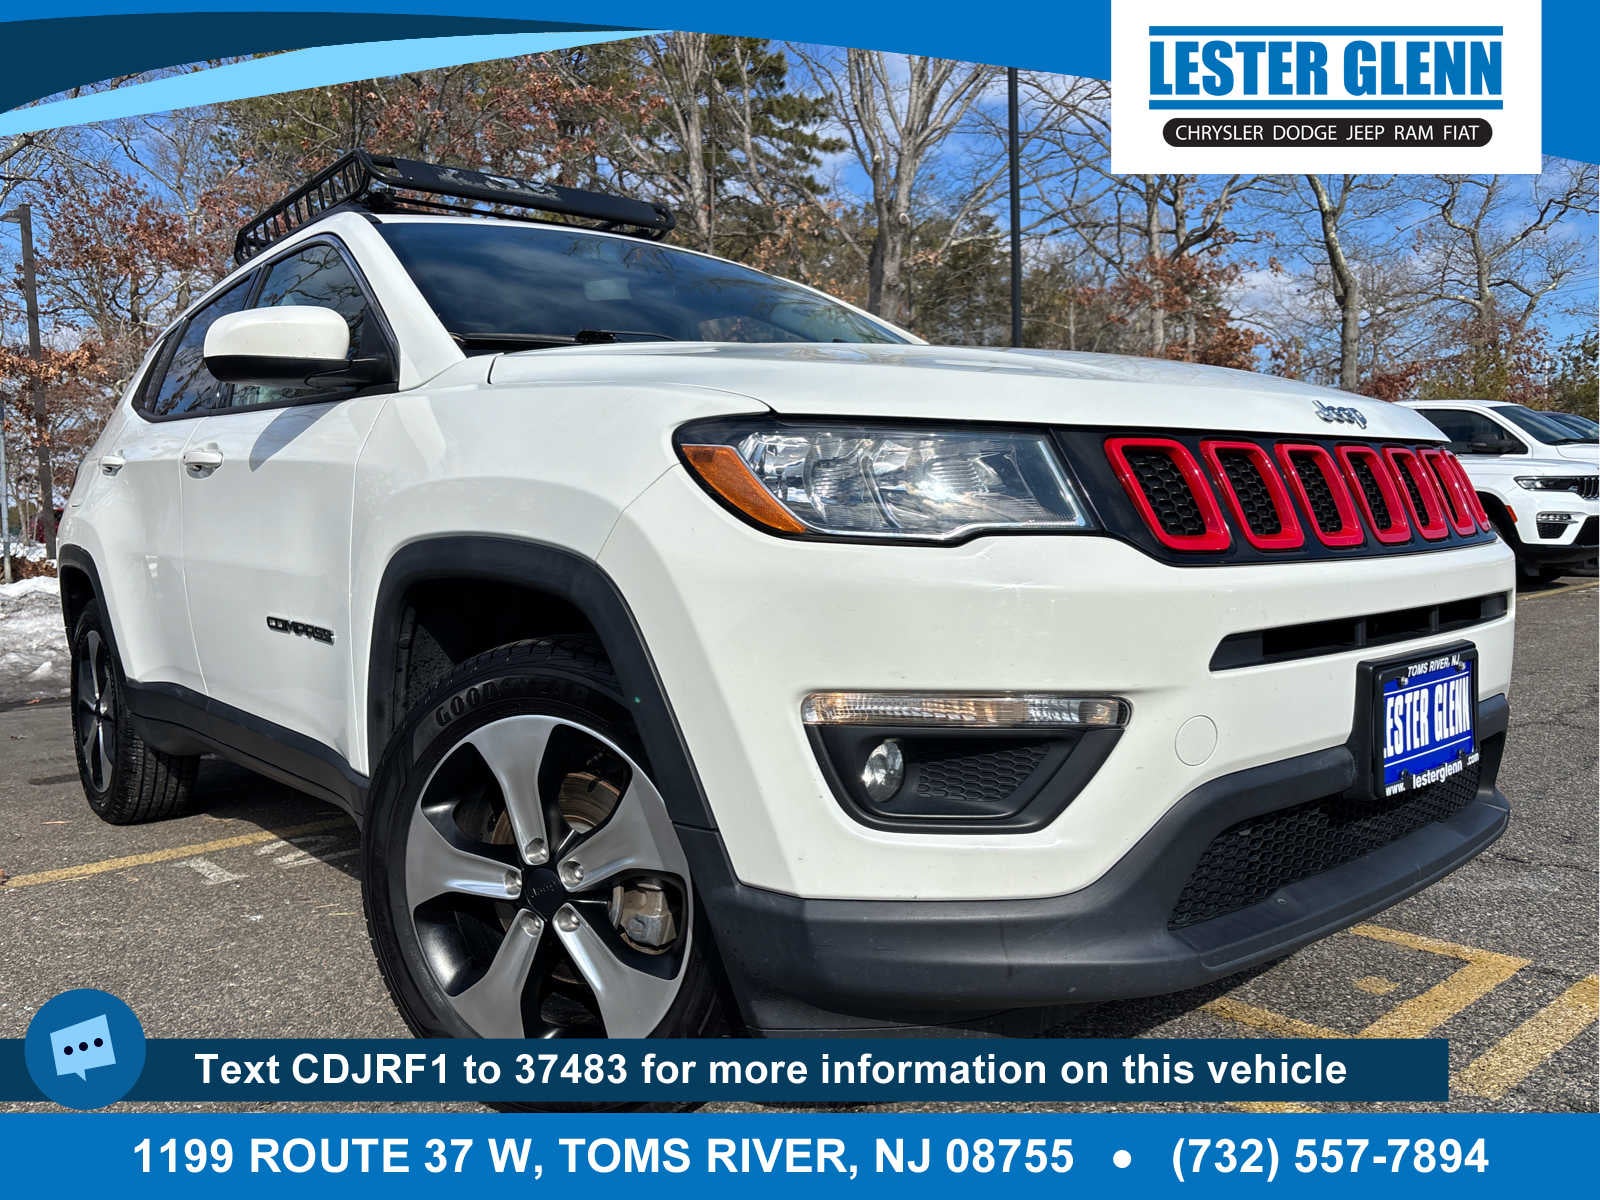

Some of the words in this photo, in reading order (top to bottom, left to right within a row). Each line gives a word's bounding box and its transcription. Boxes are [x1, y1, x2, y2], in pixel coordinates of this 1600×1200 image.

[1312, 400, 1367, 430] Jeep
[266, 616, 335, 646] COMPASS
[1408, 662, 1428, 677] TOMS
[1384, 687, 1429, 759] ESTER
[1434, 675, 1471, 742] GLENN
[1412, 760, 1463, 789] lesterglenn
